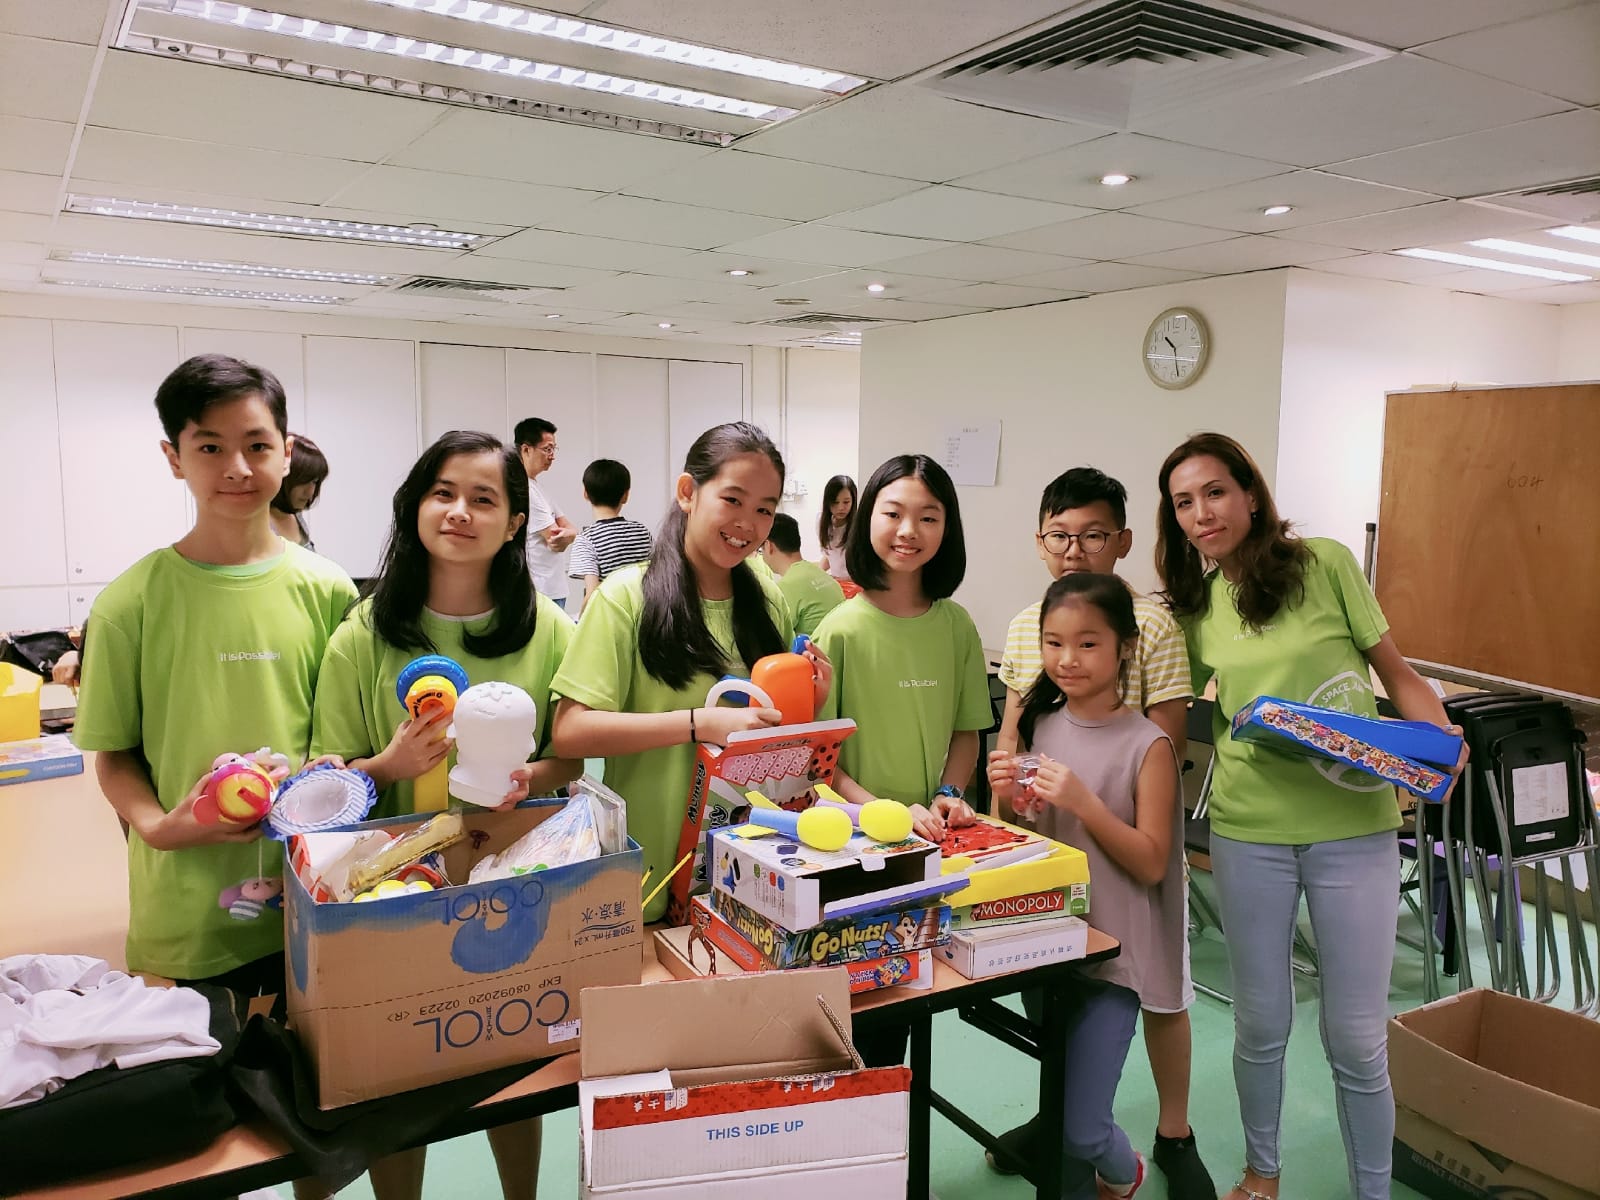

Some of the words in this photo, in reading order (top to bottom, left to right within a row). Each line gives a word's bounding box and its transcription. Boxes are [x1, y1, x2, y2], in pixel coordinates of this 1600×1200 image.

[1321, 681, 1351, 704] SPACE
[980, 894, 1063, 917] MONOPOLY
[810, 931, 842, 962] Go
[841, 921, 890, 948] Nuts!
[538, 975, 562, 989] EXP
[468, 983, 531, 1005] 08092020
[418, 1000, 460, 1016] 02223
[412, 989, 570, 1053] COOL
[486, 1006, 494, 1041] WATER
[706, 1126, 741, 1141] THIS
[744, 1121, 779, 1137] SIDE
[784, 1120, 804, 1133] UP
